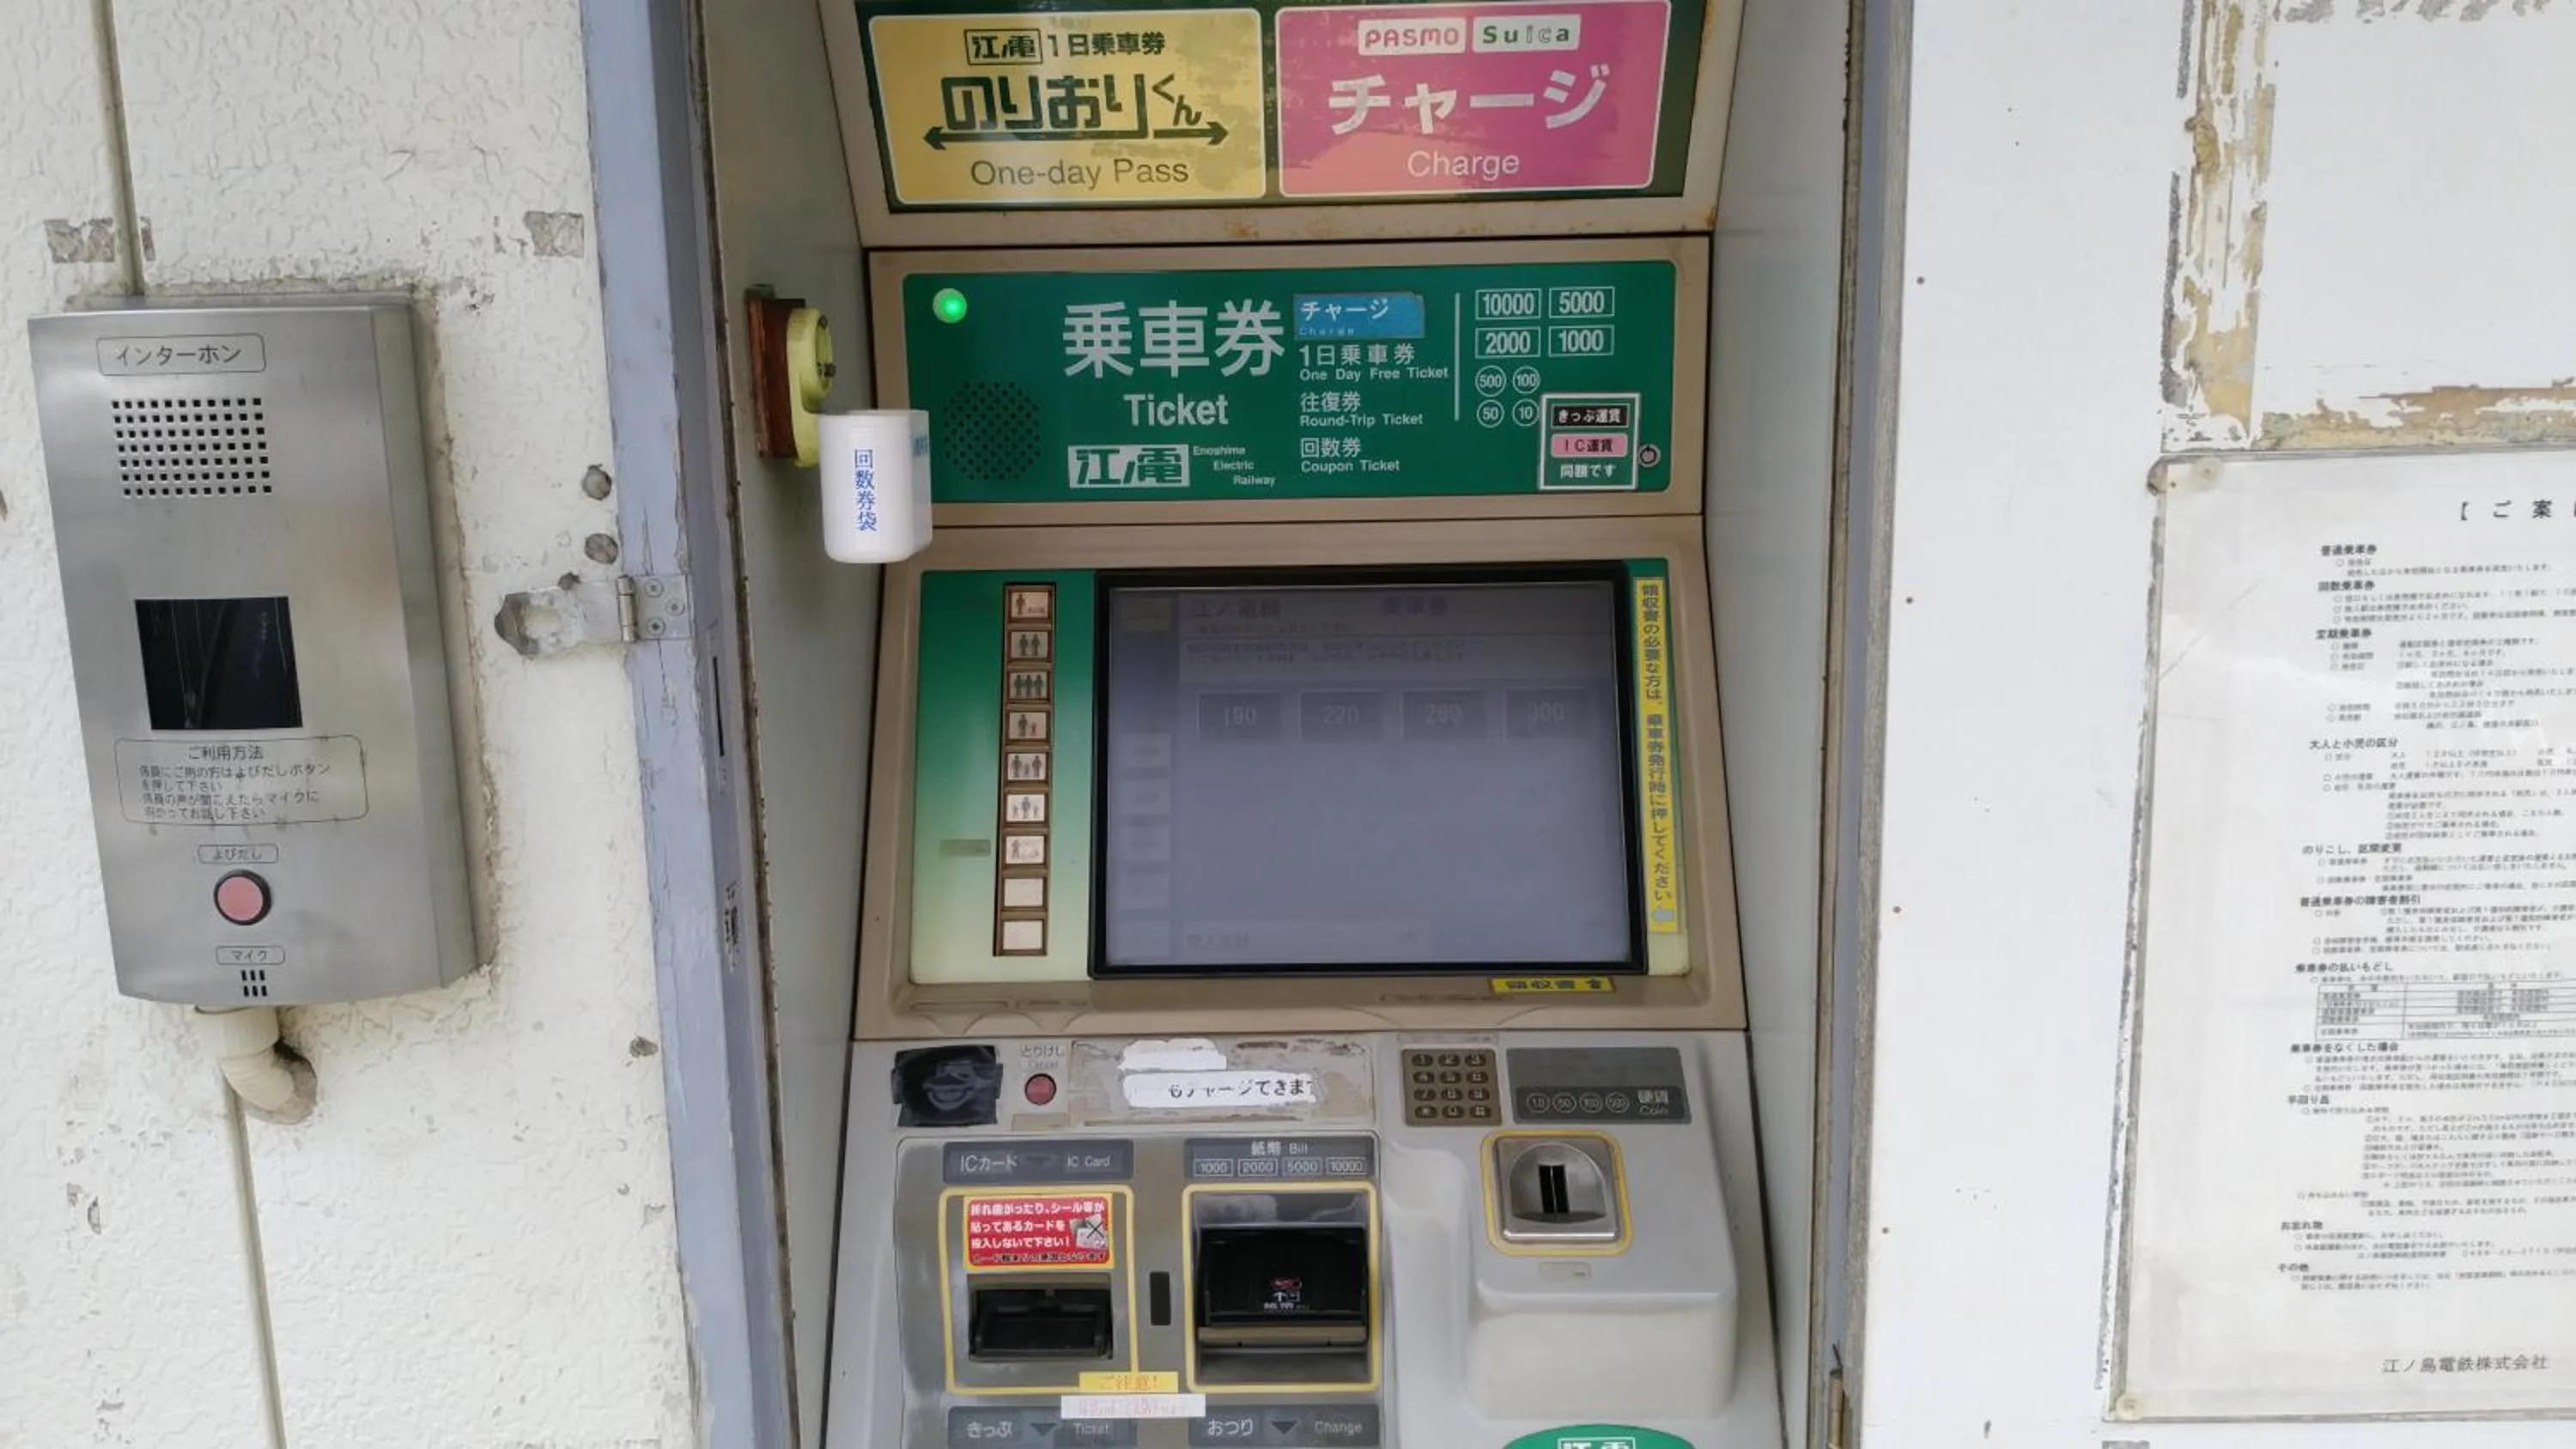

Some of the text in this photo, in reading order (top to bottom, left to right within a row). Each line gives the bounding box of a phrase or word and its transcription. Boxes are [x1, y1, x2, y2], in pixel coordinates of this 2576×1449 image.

[1047, 32, 1166, 58] 1日乗車券
[1364, 24, 1570, 49] PASMO Suica
[940, 73, 1202, 138] のりおりくん
[1327, 64, 1610, 135] チャージ
[970, 159, 1190, 191] One-day Pass
[1406, 150, 1520, 181] Charge
[1300, 298, 1389, 323] チャージ
[1482, 291, 1605, 316] 10000 5000
[1062, 298, 1285, 379] 乗車券
[1485, 329, 1605, 354] 2000 1000
[115, 344, 244, 367] インターホン
[1298, 343, 1416, 367] 1日乗車券
[1299, 366, 1449, 382] One Day Free Ticket
[1479, 373, 1538, 388] 500 100
[1124, 393, 1230, 426] Ticket
[1300, 391, 1362, 413] 往復券
[1299, 412, 1424, 428] Round-Trip Ticket
[1483, 406, 1533, 421] 50 10
[1300, 436, 1362, 458] 回数券
[1213, 459, 1255, 471] Electric
[1301, 458, 1400, 475] Coupon Ticket
[854, 448, 878, 532] 回数券袋
[1233, 474, 1276, 487] Railway
[230, 949, 270, 961] マイク
[1289, 1143, 1309, 1155] Bill
[960, 1155, 1018, 1173] ICカード
[1084, 1155, 1113, 1168] Card
[2381, 1354, 2550, 1373] 江ノ島電鉄株式会社
[966, 1421, 1014, 1439] きっぷ
[1207, 1418, 1254, 1437] おつり
[1314, 1420, 1364, 1436] Change
